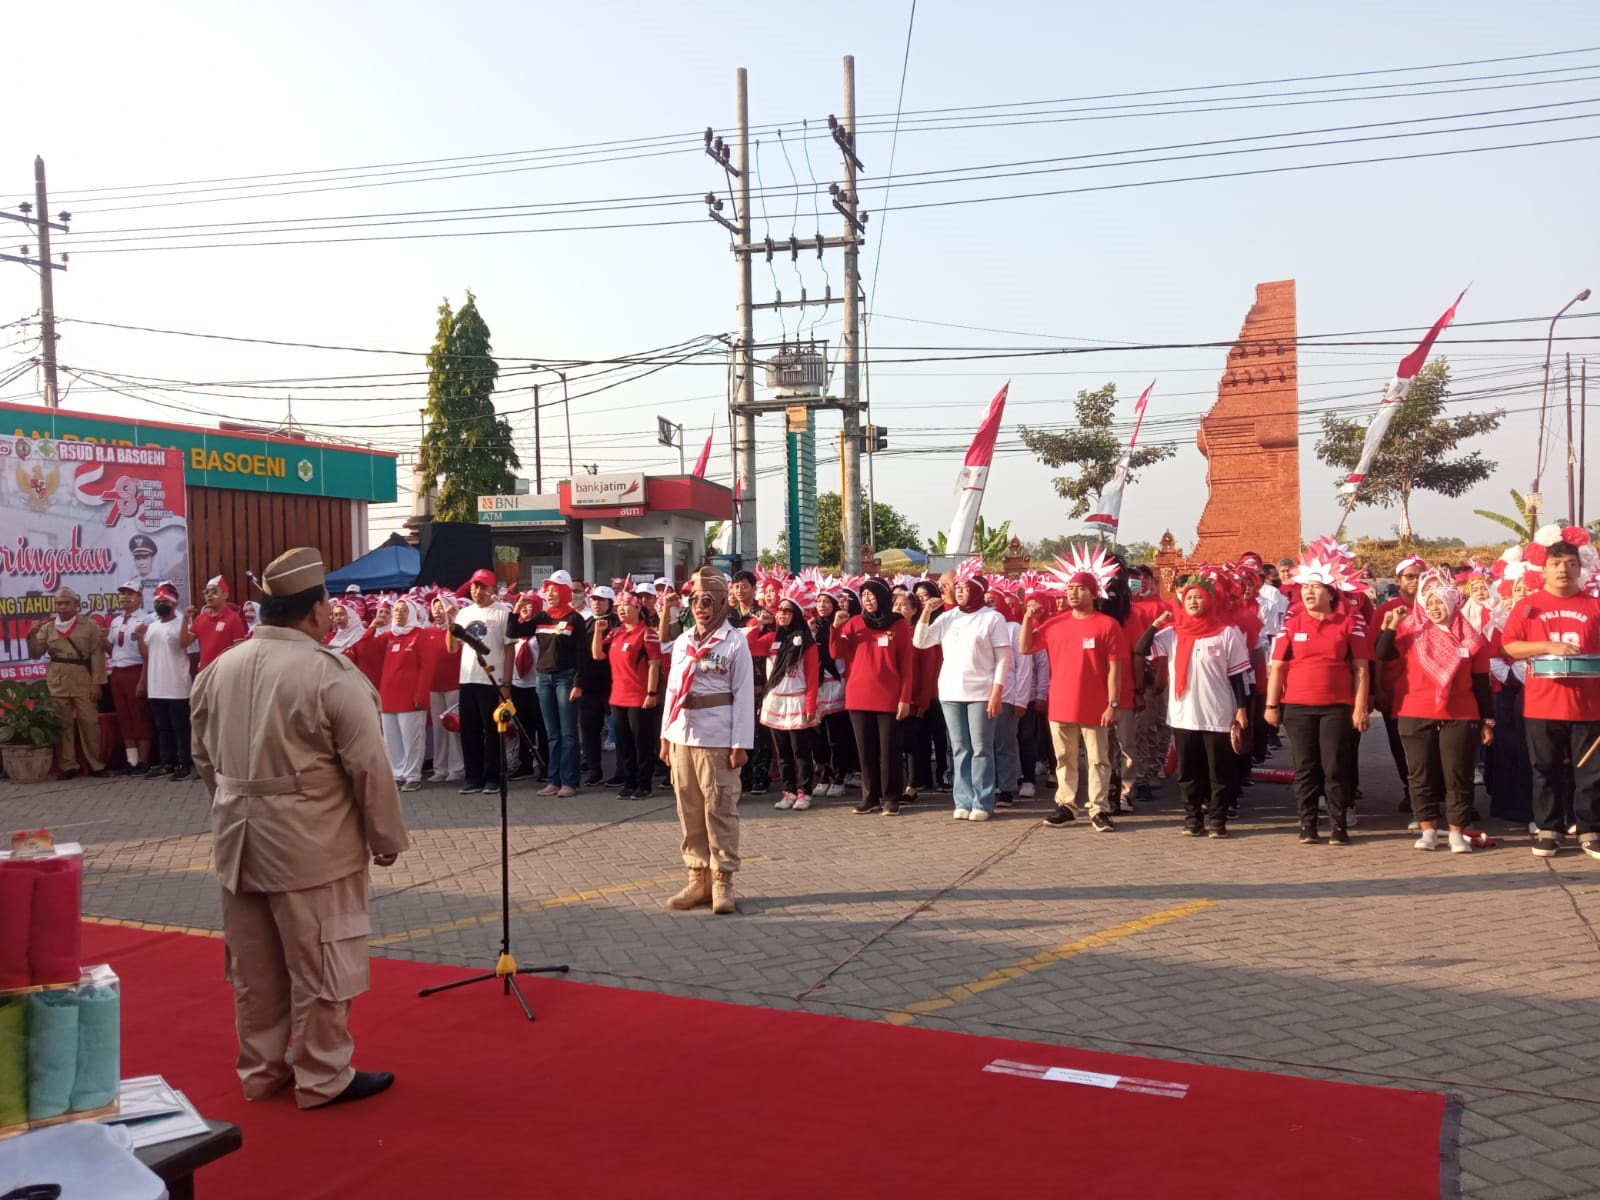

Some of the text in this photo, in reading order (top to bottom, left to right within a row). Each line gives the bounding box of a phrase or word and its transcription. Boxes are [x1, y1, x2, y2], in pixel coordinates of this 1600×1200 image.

[59, 443, 166, 466] RSUD R.A BASOENI
[190, 447, 286, 478] BASOENI
[575, 481, 627, 494] bankjatim
[495, 497, 519, 509] BNI
[482, 511, 503, 521] ATM
[620, 506, 640, 516] atm
[89, 594, 103, 610] 78
[18, 664, 47, 677] 1945
